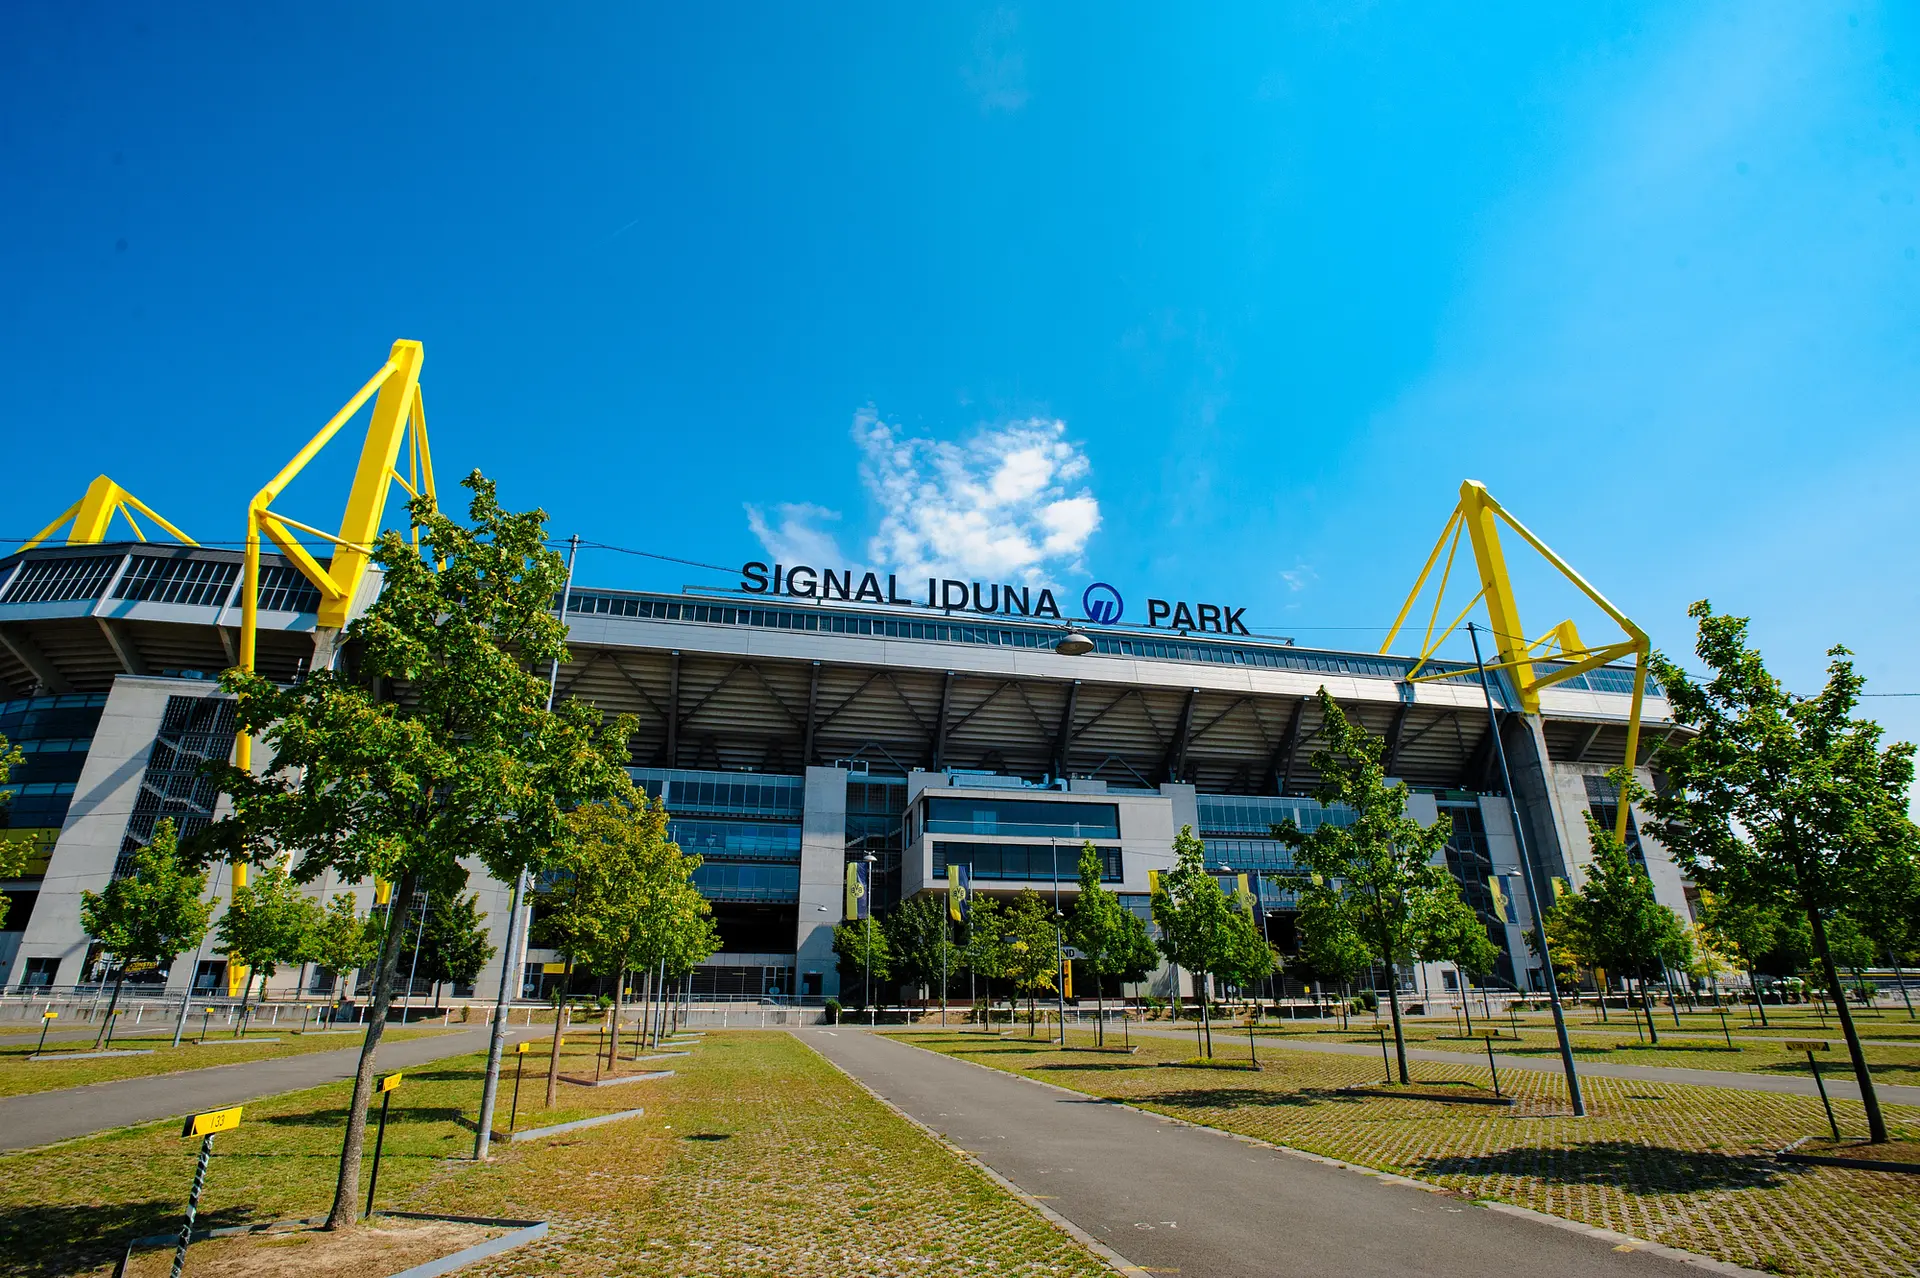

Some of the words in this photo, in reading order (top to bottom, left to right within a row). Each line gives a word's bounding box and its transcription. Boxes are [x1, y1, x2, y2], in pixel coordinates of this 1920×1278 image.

[740, 562, 911, 605] SIGNAL
[928, 578, 1061, 618] IDUNA
[1147, 598, 1251, 636] PARK
[210, 1114, 225, 1128] 133
